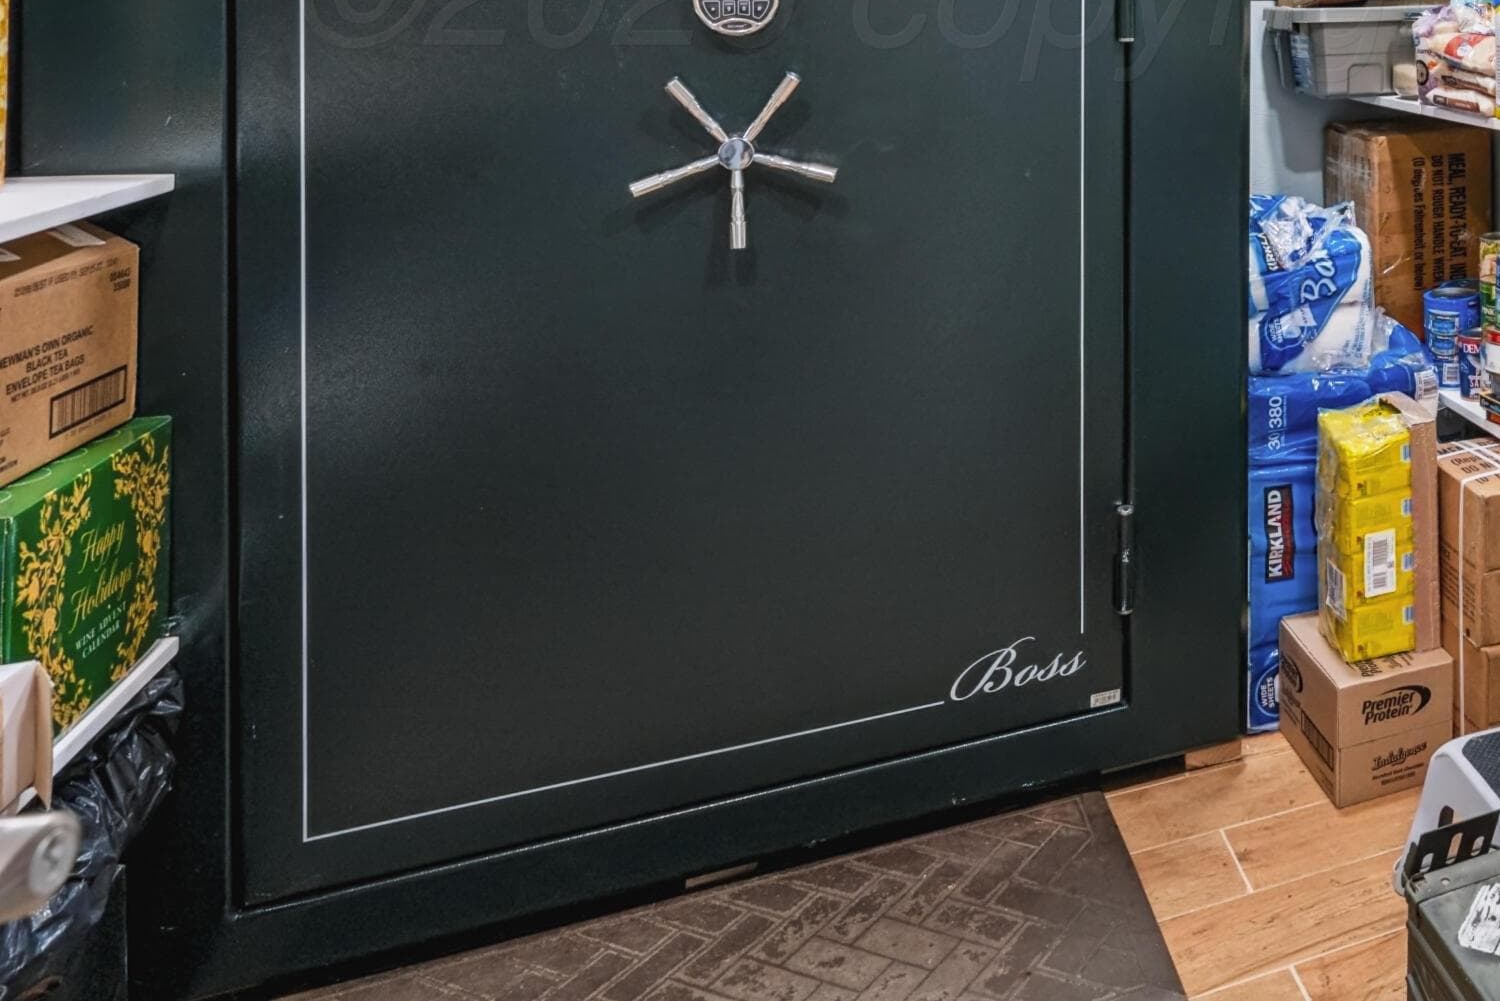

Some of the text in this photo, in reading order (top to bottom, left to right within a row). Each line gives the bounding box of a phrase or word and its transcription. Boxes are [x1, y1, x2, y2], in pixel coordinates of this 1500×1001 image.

[1431, 155, 1446, 256] DO NOT ROUGH HANDLE
[42, 338, 60, 354] OWN
[61, 325, 94, 346] ORGANIC
[6, 369, 49, 396] ENVELOPE
[50, 363, 64, 378] TEA
[65, 354, 85, 371] BAGS
[26, 348, 69, 373] BLACK TEA
[1268, 396, 1283, 429] 380
[77, 520, 126, 574] Happy
[1266, 488, 1284, 578] KIRKLAND
[950, 636, 1087, 701] Boss
[1361, 691, 1415, 715] Premier
[1364, 705, 1412, 726] Protein
